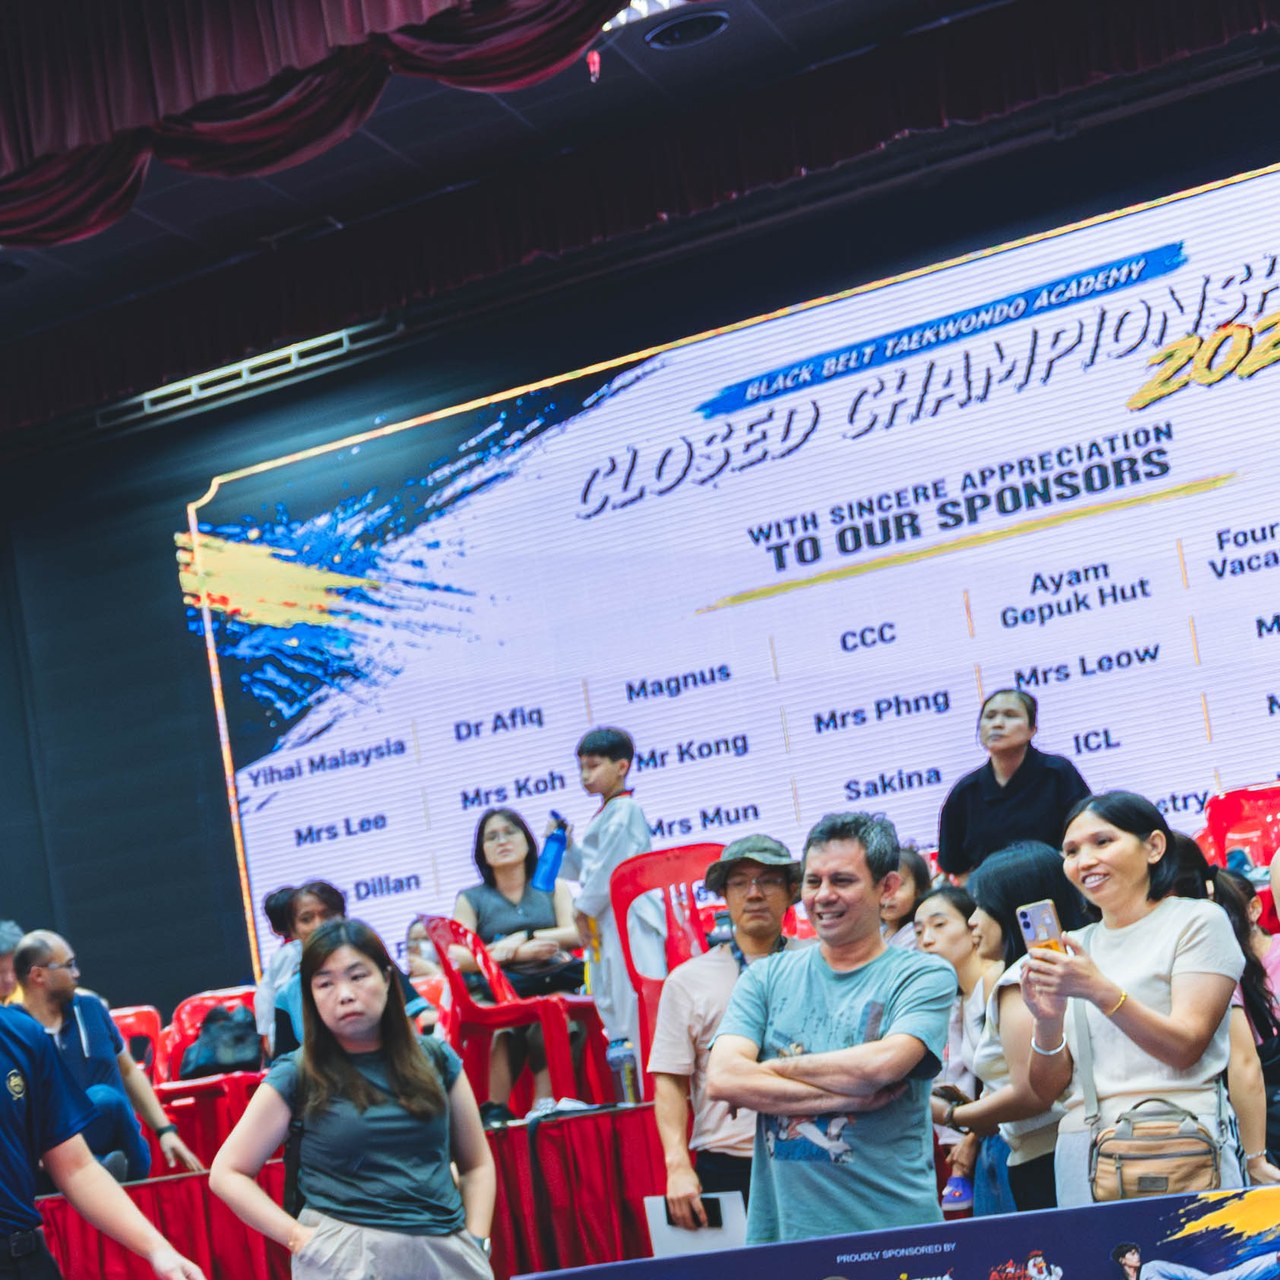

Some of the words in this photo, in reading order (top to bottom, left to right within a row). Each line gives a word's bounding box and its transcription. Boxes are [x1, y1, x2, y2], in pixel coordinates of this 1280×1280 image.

[744, 363, 814, 401] BLACK
[821, 347, 875, 378] BELT
[885, 300, 1027, 357] TAEKWONDO
[1033, 258, 1147, 310] ACADEMY
[576, 400, 821, 519] CLOSED
[748, 511, 819, 545] WITH
[829, 478, 947, 524] SINCERE
[960, 422, 1174, 491] APPRECIATION
[766, 536, 821, 571] TO
[837, 511, 922, 554] OUR
[937, 448, 1171, 530] SPONSORS
[1030, 562, 1110, 597] Ayam
[1000, 591, 1090, 628] Gepuk
[1098, 577, 1151, 607] Hut
[840, 622, 896, 652] CCC
[626, 663, 731, 703] Magnus
[1014, 663, 1070, 690] Mrs
[1079, 643, 1161, 677] Leow
[453, 720, 483, 742] Dr
[492, 706, 545, 733] Afiq
[814, 704, 868, 734] Mrs
[875, 689, 951, 721] Phng
[635, 749, 669, 772] Mr
[676, 733, 750, 763] Kong
[1073, 728, 1121, 755] ICL
[247, 760, 303, 787] Yihai
[308, 737, 406, 772] Malaysia
[460, 786, 508, 811] Mrs
[515, 771, 566, 798] Koh
[843, 766, 942, 801] Sakina
[295, 823, 339, 847] Mrs
[344, 813, 387, 837] Lee
[650, 815, 692, 838] Mrs
[700, 803, 759, 831] Mun
[353, 872, 420, 901] Dillan
[837, 1250, 880, 1264] PROUDLY
[882, 1243, 942, 1259] SPONSORED
[944, 1242, 957, 1252] BY
